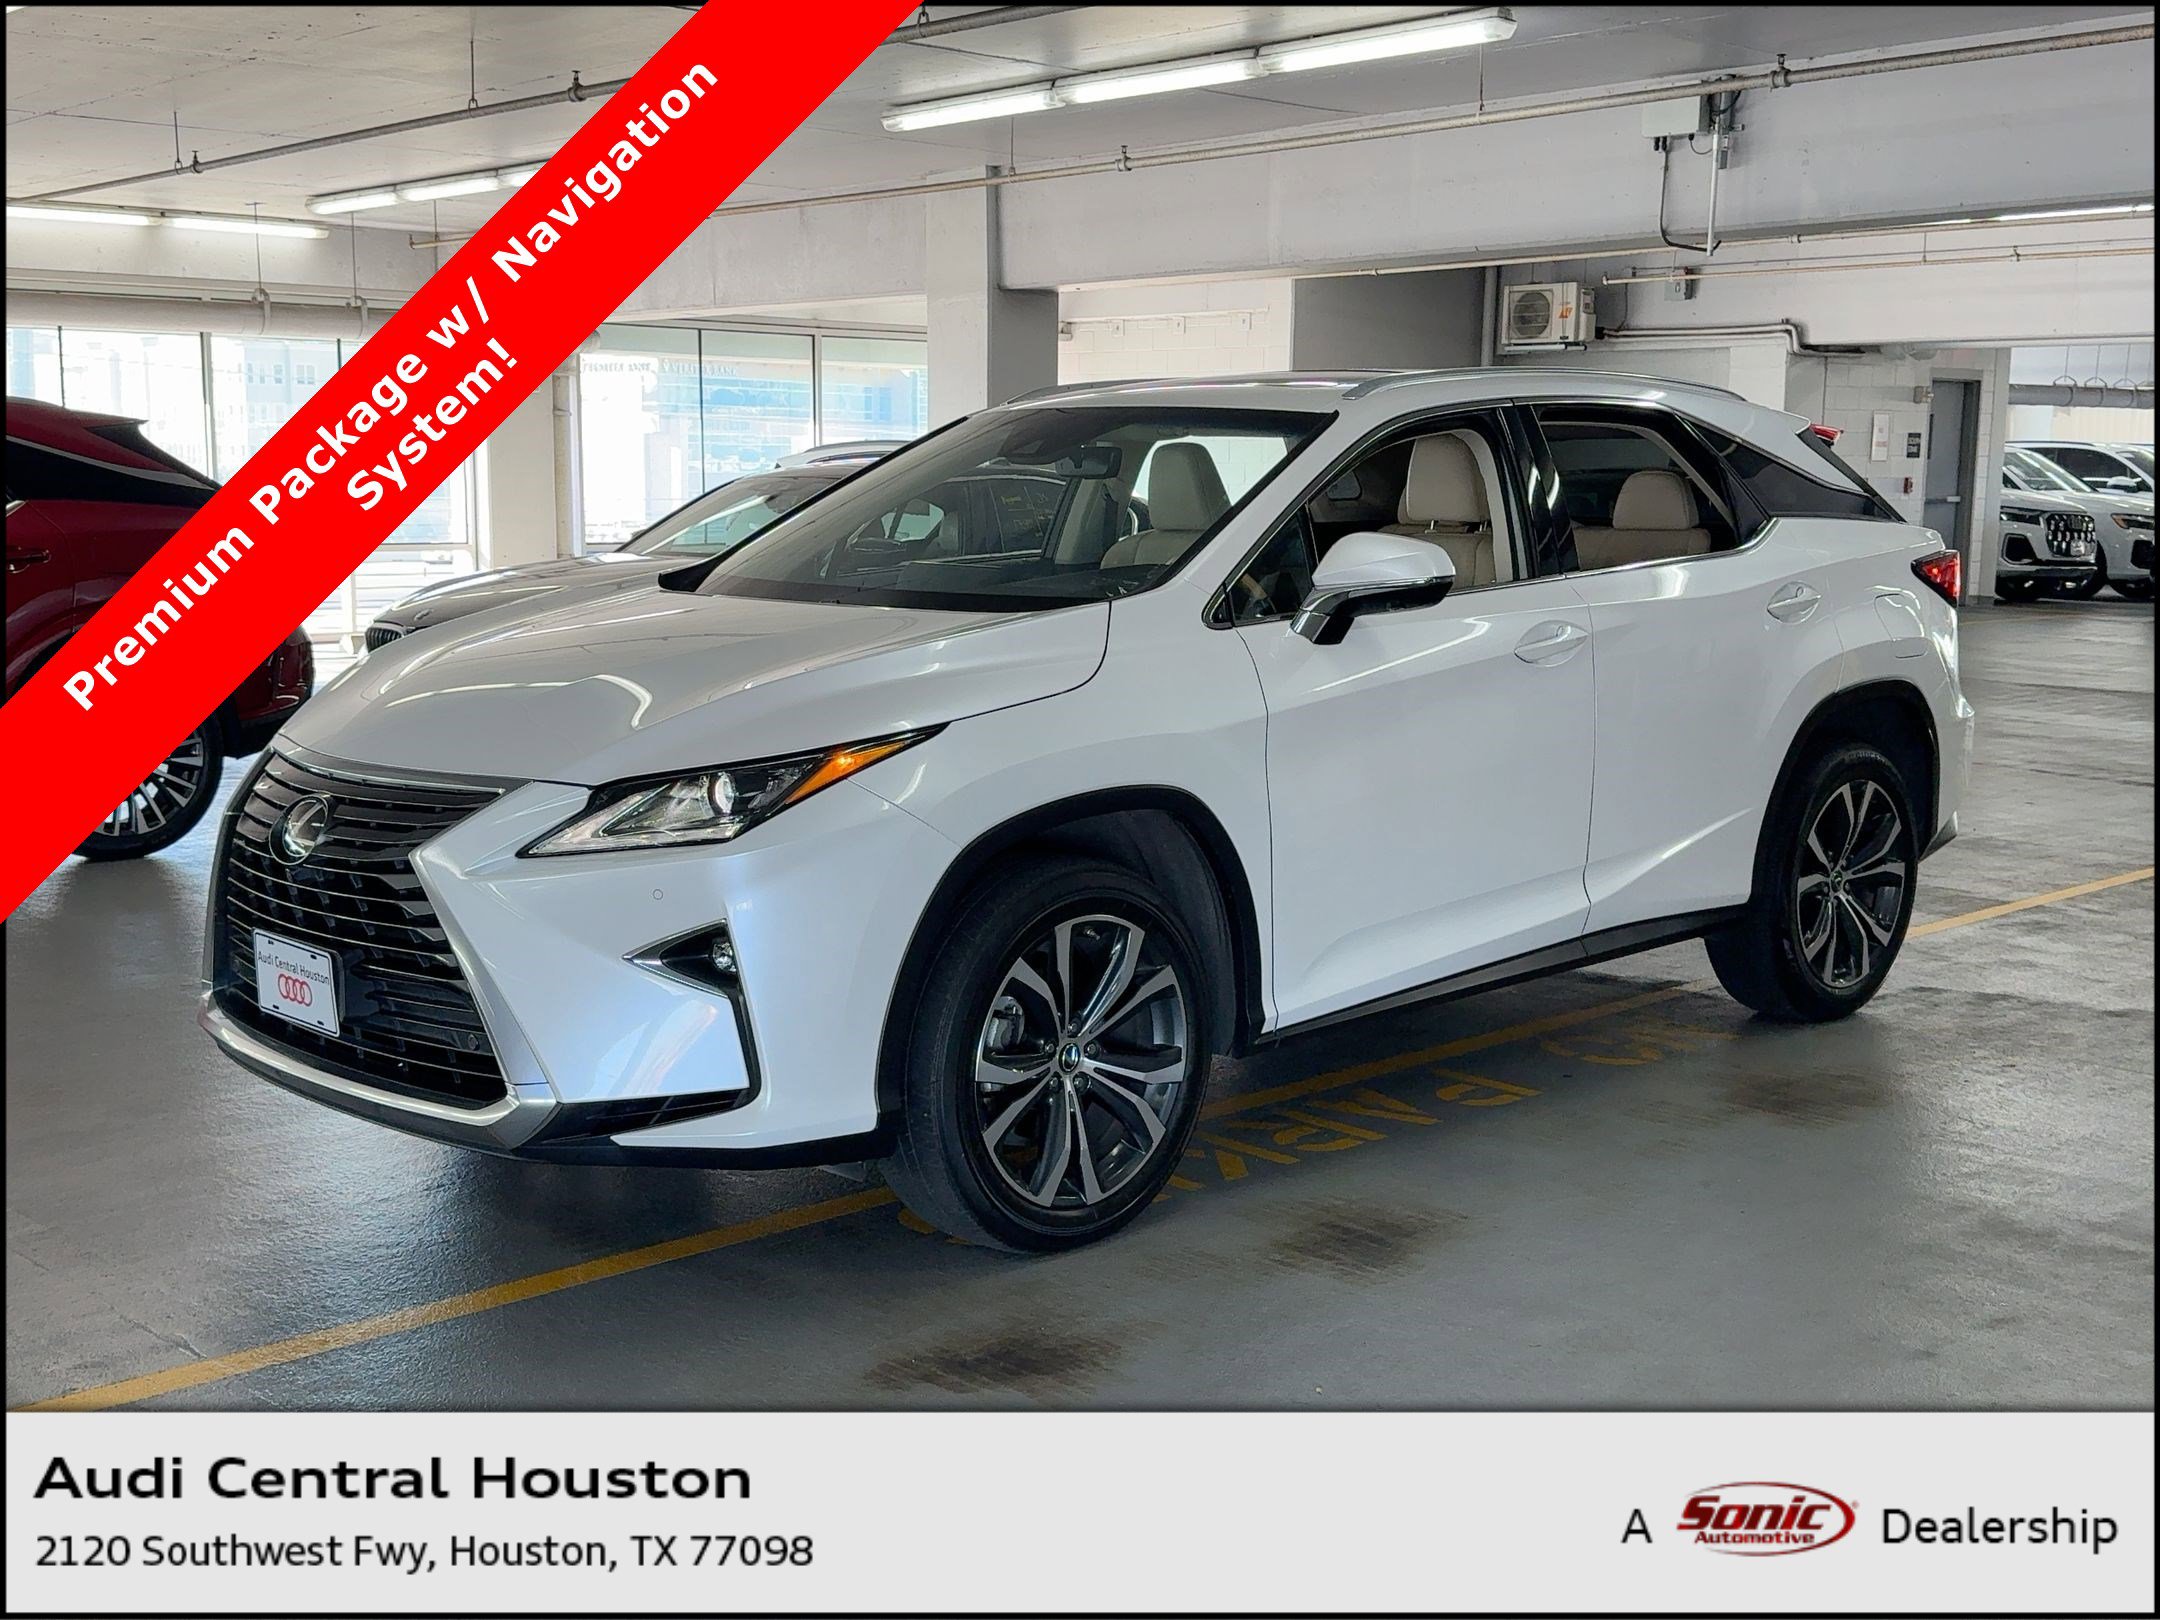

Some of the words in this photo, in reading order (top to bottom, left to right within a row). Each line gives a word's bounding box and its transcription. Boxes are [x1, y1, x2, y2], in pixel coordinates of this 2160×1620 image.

[258, 951, 274, 965] Audi
[275, 955, 299, 975] Central
[299, 963, 330, 986] Houston
